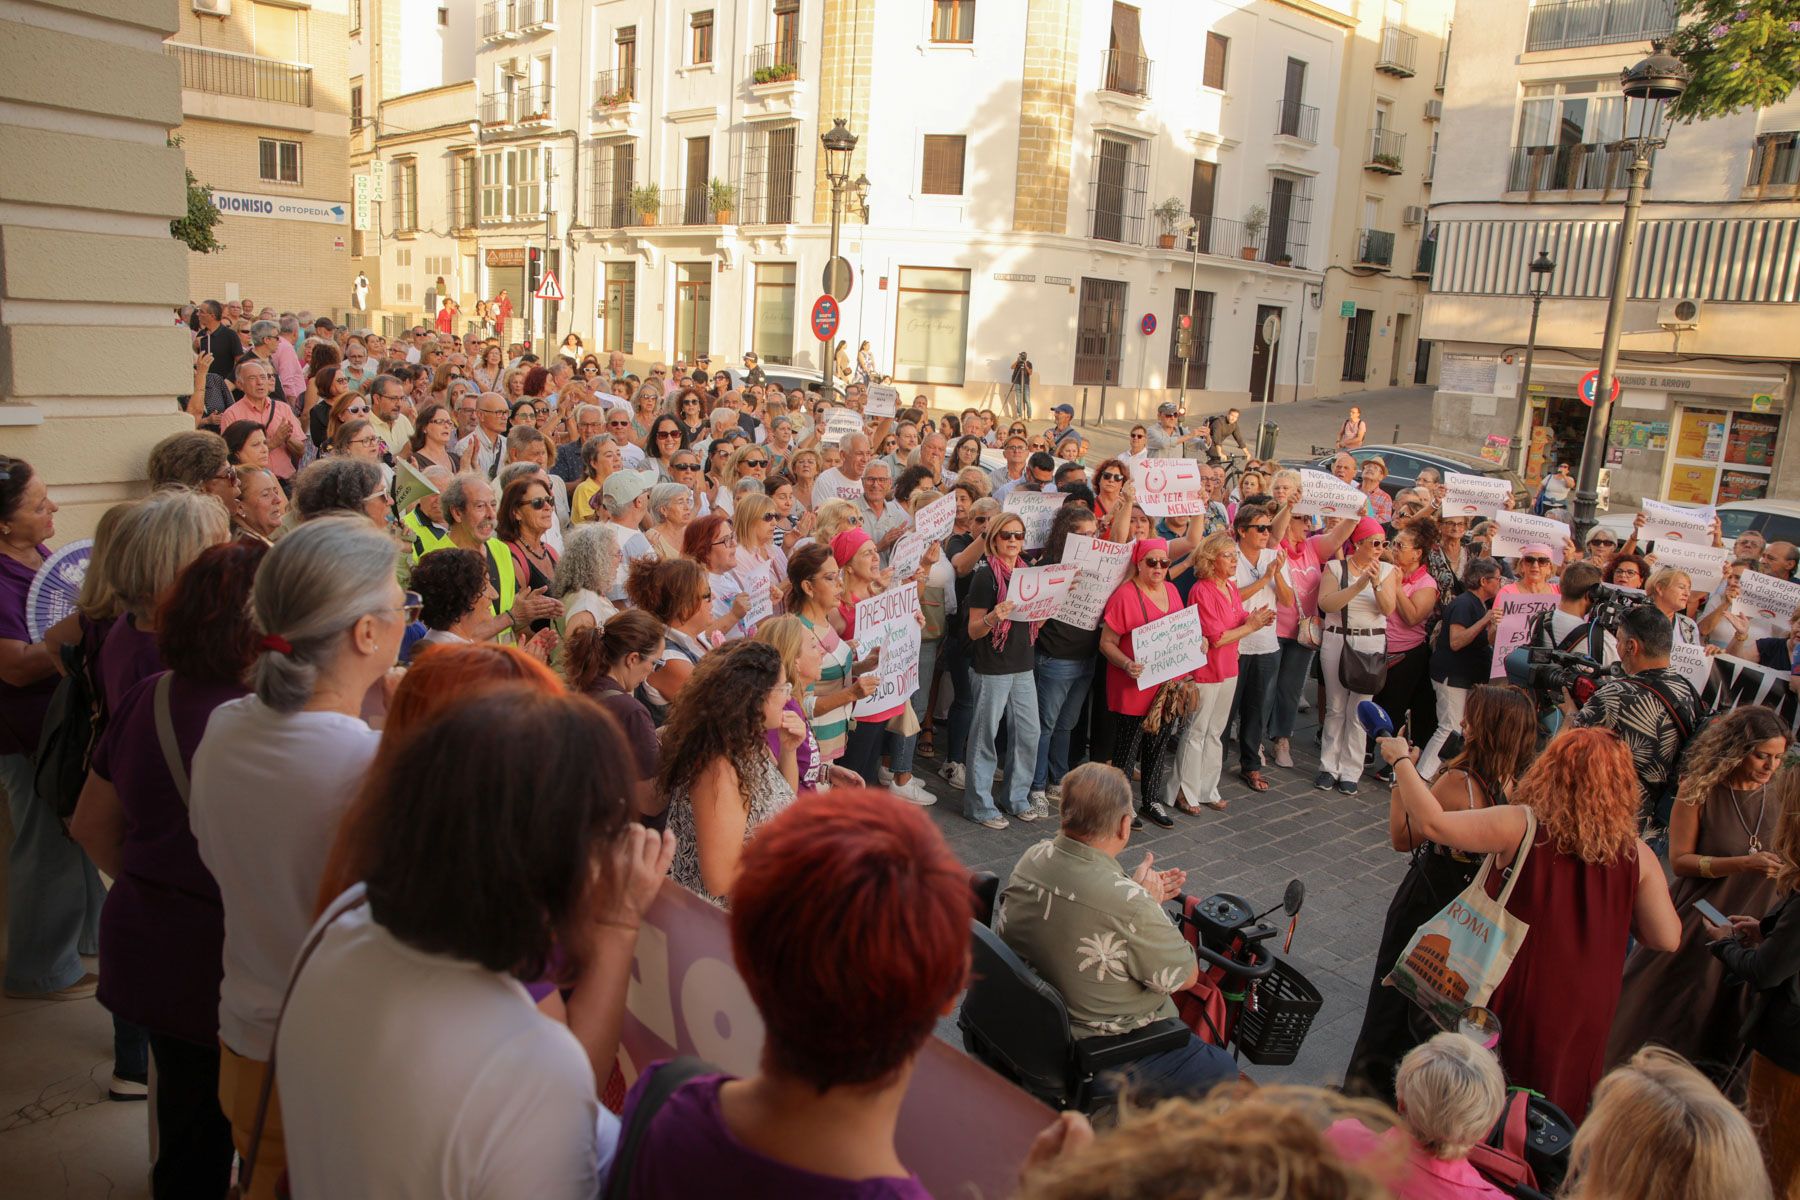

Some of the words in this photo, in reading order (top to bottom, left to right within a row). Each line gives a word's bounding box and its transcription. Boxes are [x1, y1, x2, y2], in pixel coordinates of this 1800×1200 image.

[219, 196, 273, 214] DIONISIO
[278, 204, 330, 217] ORTOPEDIA
[1649, 378, 1658, 387] EL
[1661, 378, 1691, 389] ARROYO
[1302, 480, 1314, 488] sin
[1450, 476, 1492, 488] Queremos
[1145, 493, 1160, 504] UNA
[1163, 491, 1183, 503] TETA
[1300, 498, 1317, 506] nos
[1306, 489, 1345, 501] Nosotras
[1347, 493, 1358, 502] no
[1477, 490, 1500, 500] digno
[1167, 501, 1201, 515] MENOS
[933, 507, 957, 528] MATAN
[1510, 514, 1523, 524] No
[1524, 517, 1554, 529] somos
[1658, 517, 1706, 532] abandono.
[1499, 534, 1530, 545] somos
[1508, 526, 1552, 540] números,
[1656, 544, 1670, 553] No
[1671, 548, 1682, 556] es
[1684, 550, 1696, 559] un
[1740, 580, 1754, 591] sin
[1750, 573, 1770, 586] Nos
[1737, 596, 1754, 606] nos
[1743, 590, 1787, 609] Nosotras
[859, 586, 918, 631] PRESIDENTE
[1503, 601, 1557, 616] NUESTRA
[1137, 620, 1166, 636] BONILLA
[1136, 637, 1149, 650] LAS
[1671, 644, 1699, 655] jaron
[1154, 642, 1184, 661] DINERO
[1150, 652, 1189, 675] PRIVADA
[1670, 653, 1705, 667] óstico.
[1679, 665, 1693, 675] no
[866, 681, 896, 704] SALUD
[1446, 900, 1490, 944] ROMA
